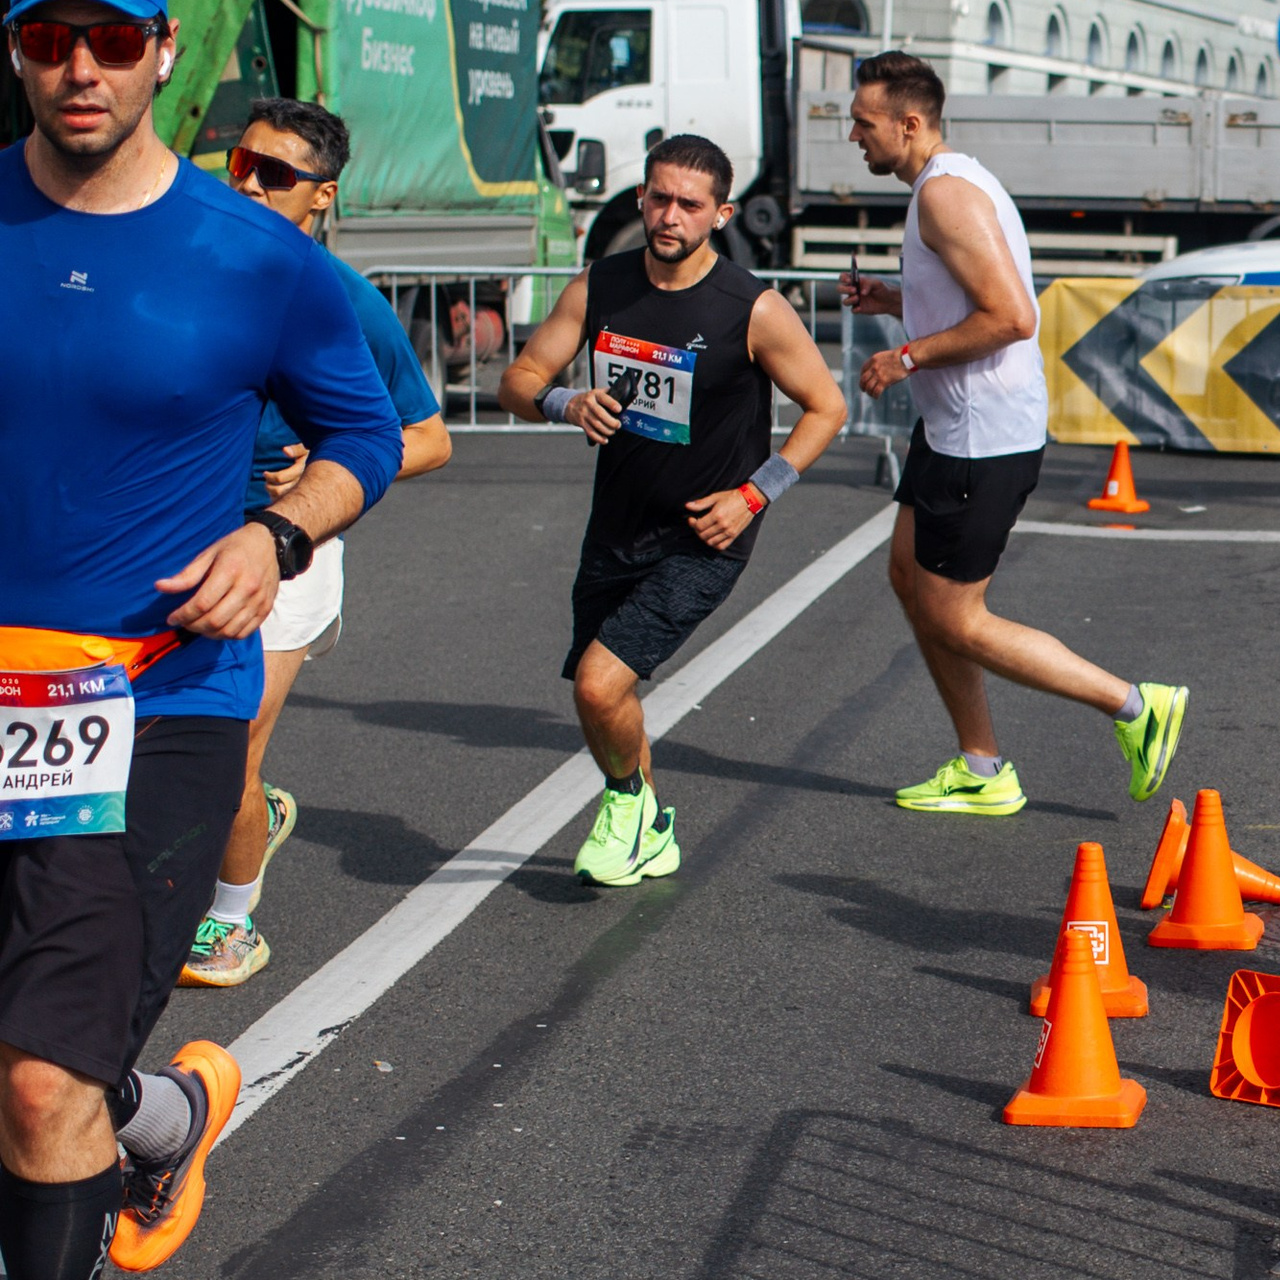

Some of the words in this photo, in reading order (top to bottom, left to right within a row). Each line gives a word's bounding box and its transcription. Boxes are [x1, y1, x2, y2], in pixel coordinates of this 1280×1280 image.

[469, 21, 484, 50] на
[485, 19, 520, 54] новый
[361, 26, 415, 76] Бизнес
[652, 349, 666, 361] 21,1
[668, 352, 683, 364] КМ
[47, 682, 75, 698] 21,1
[79, 678, 106, 695] КМ
[0, 714, 110, 769] 269
[3, 769, 73, 791] АНДРЕЙ
